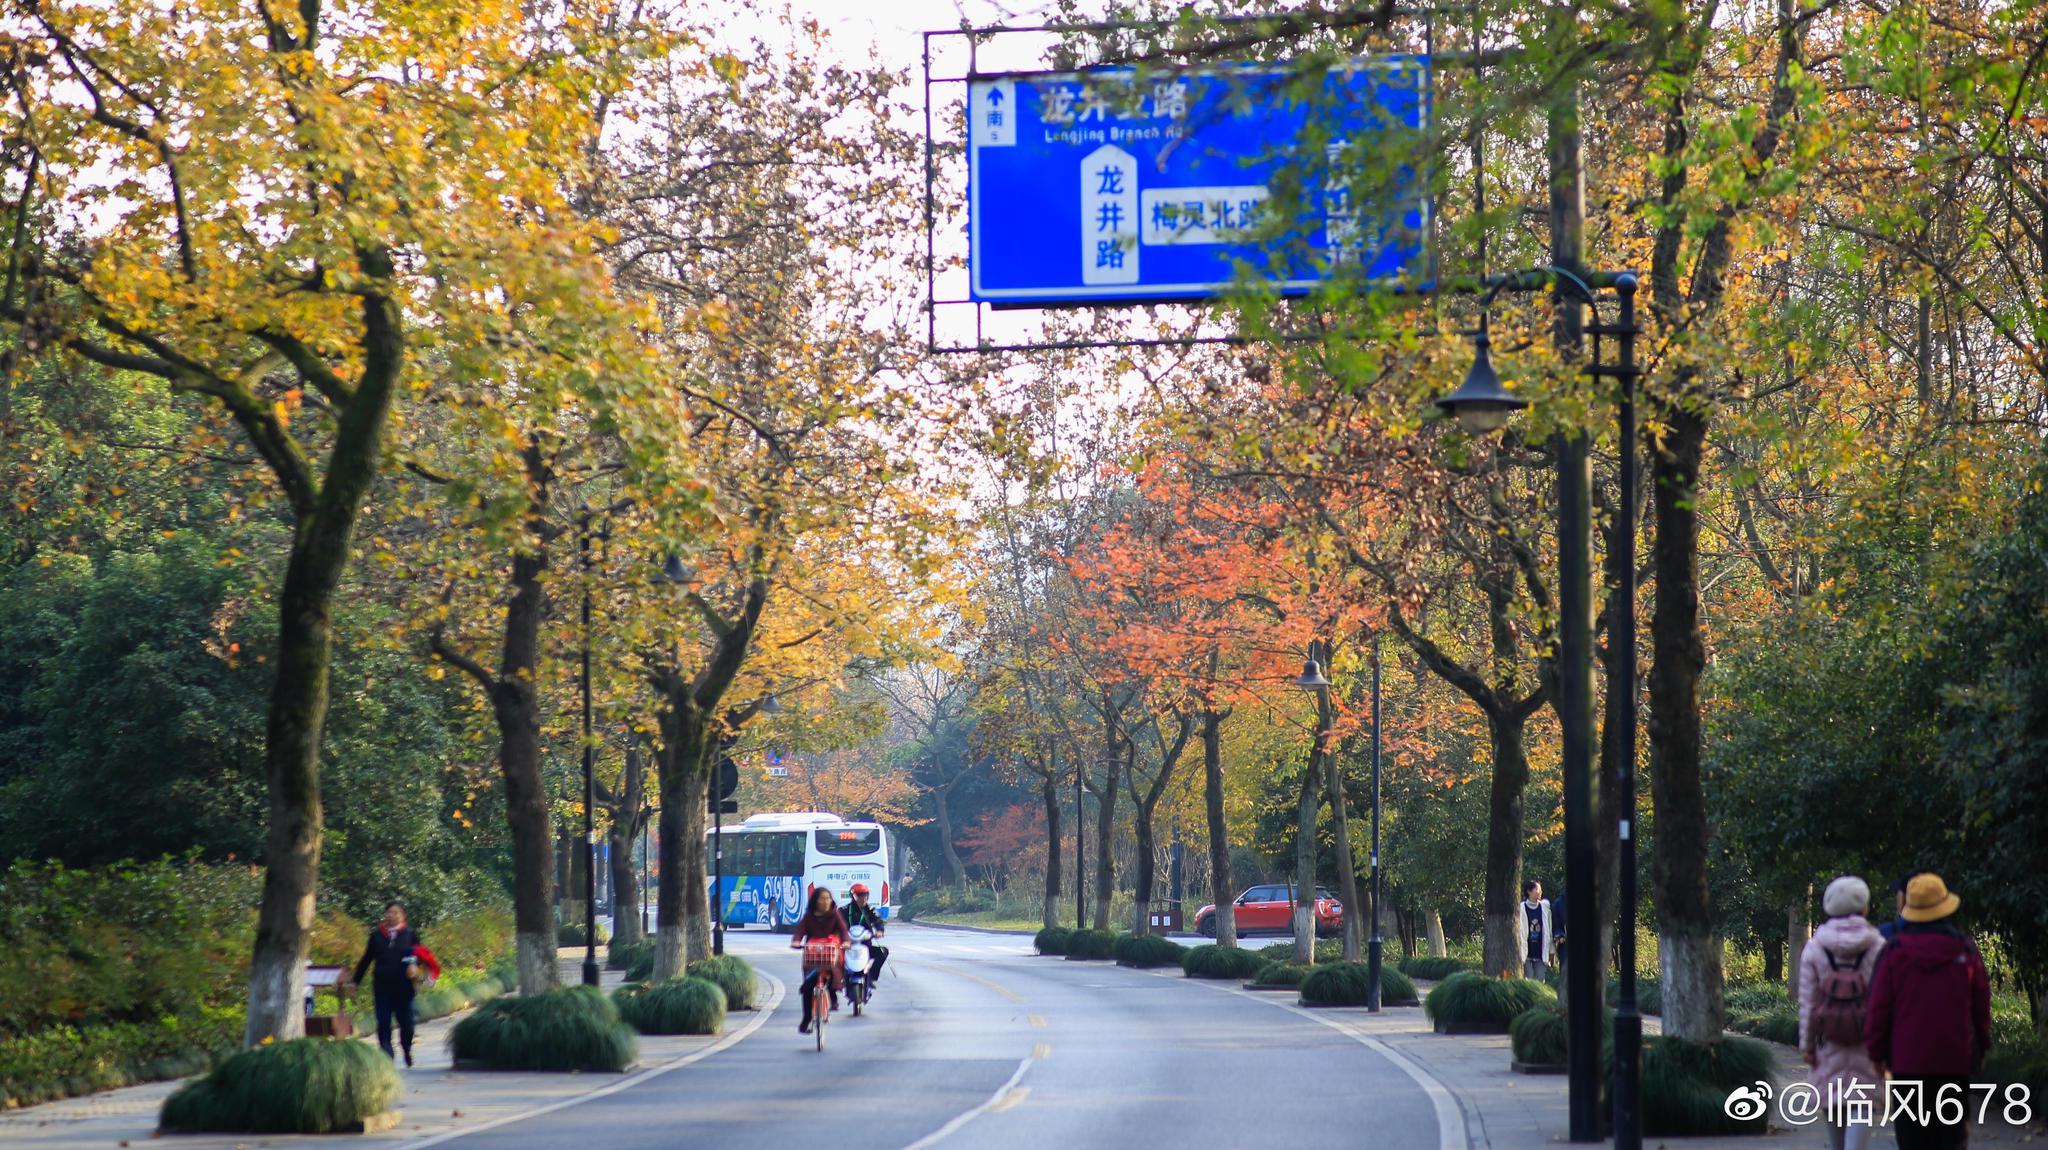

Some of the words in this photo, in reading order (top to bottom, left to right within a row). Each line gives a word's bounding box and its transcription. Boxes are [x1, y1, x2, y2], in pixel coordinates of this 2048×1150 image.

[986, 108, 1003, 127] 南
[991, 131, 999, 142] S
[1110, 126, 1160, 142] Branch
[1095, 164, 1125, 269] 龙井路
[1151, 200, 1267, 231] 梅灵北路
